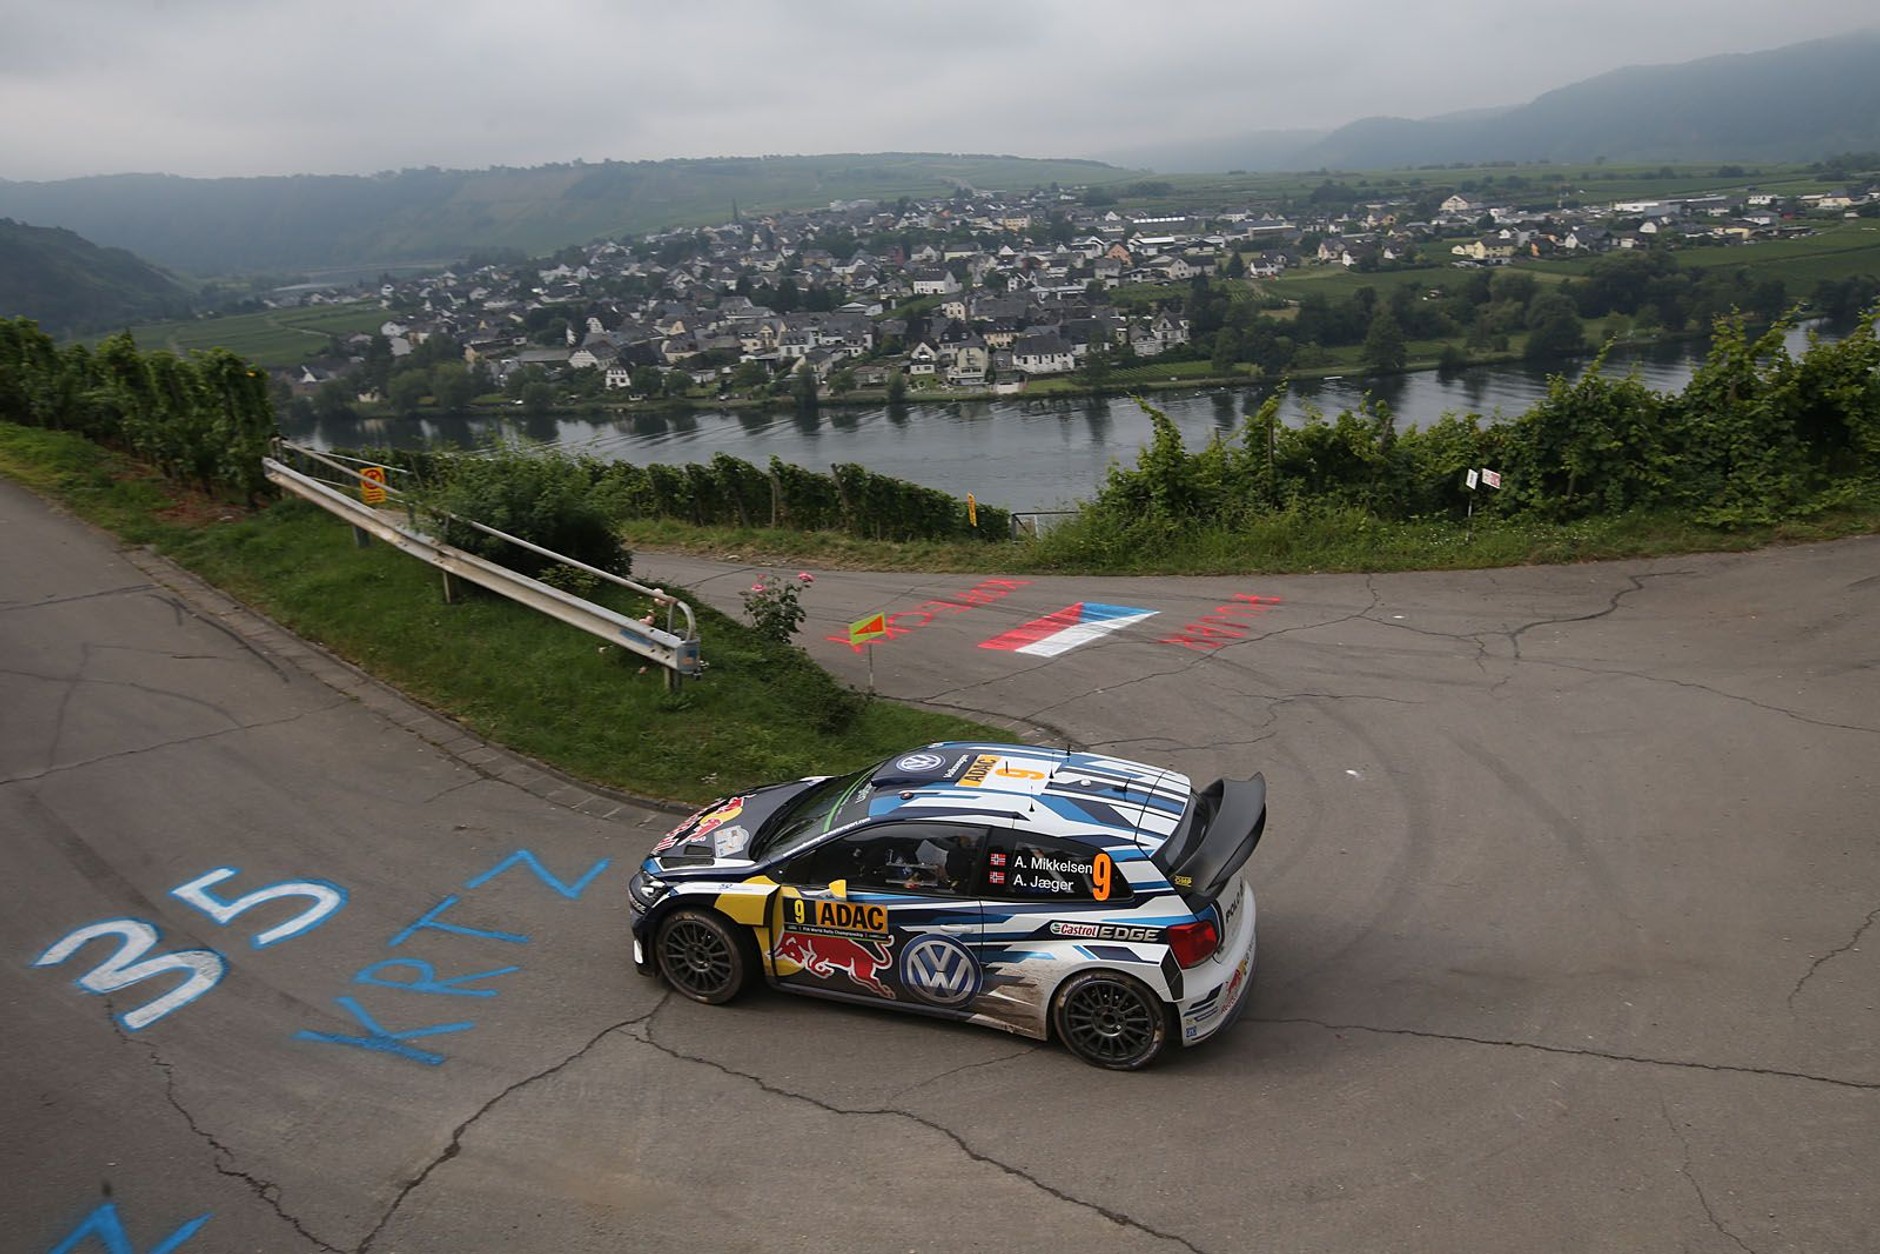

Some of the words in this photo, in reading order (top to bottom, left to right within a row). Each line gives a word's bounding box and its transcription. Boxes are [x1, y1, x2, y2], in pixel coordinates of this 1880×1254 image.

[964, 758, 997, 782] ADAC
[995, 768, 1046, 780] 9
[1014, 856, 1027, 869] A.
[1031, 857, 1093, 875] Mikkelsen
[1093, 853, 1111, 902] 9
[1013, 874, 1027, 887] A.
[1030, 876, 1074, 893] Jæger
[794, 899, 805, 924] 9
[820, 902, 883, 930] ADAC
[1061, 923, 1097, 937] Castrol
[1098, 926, 1160, 942] EDGE
[30, 866, 349, 1031] 35
